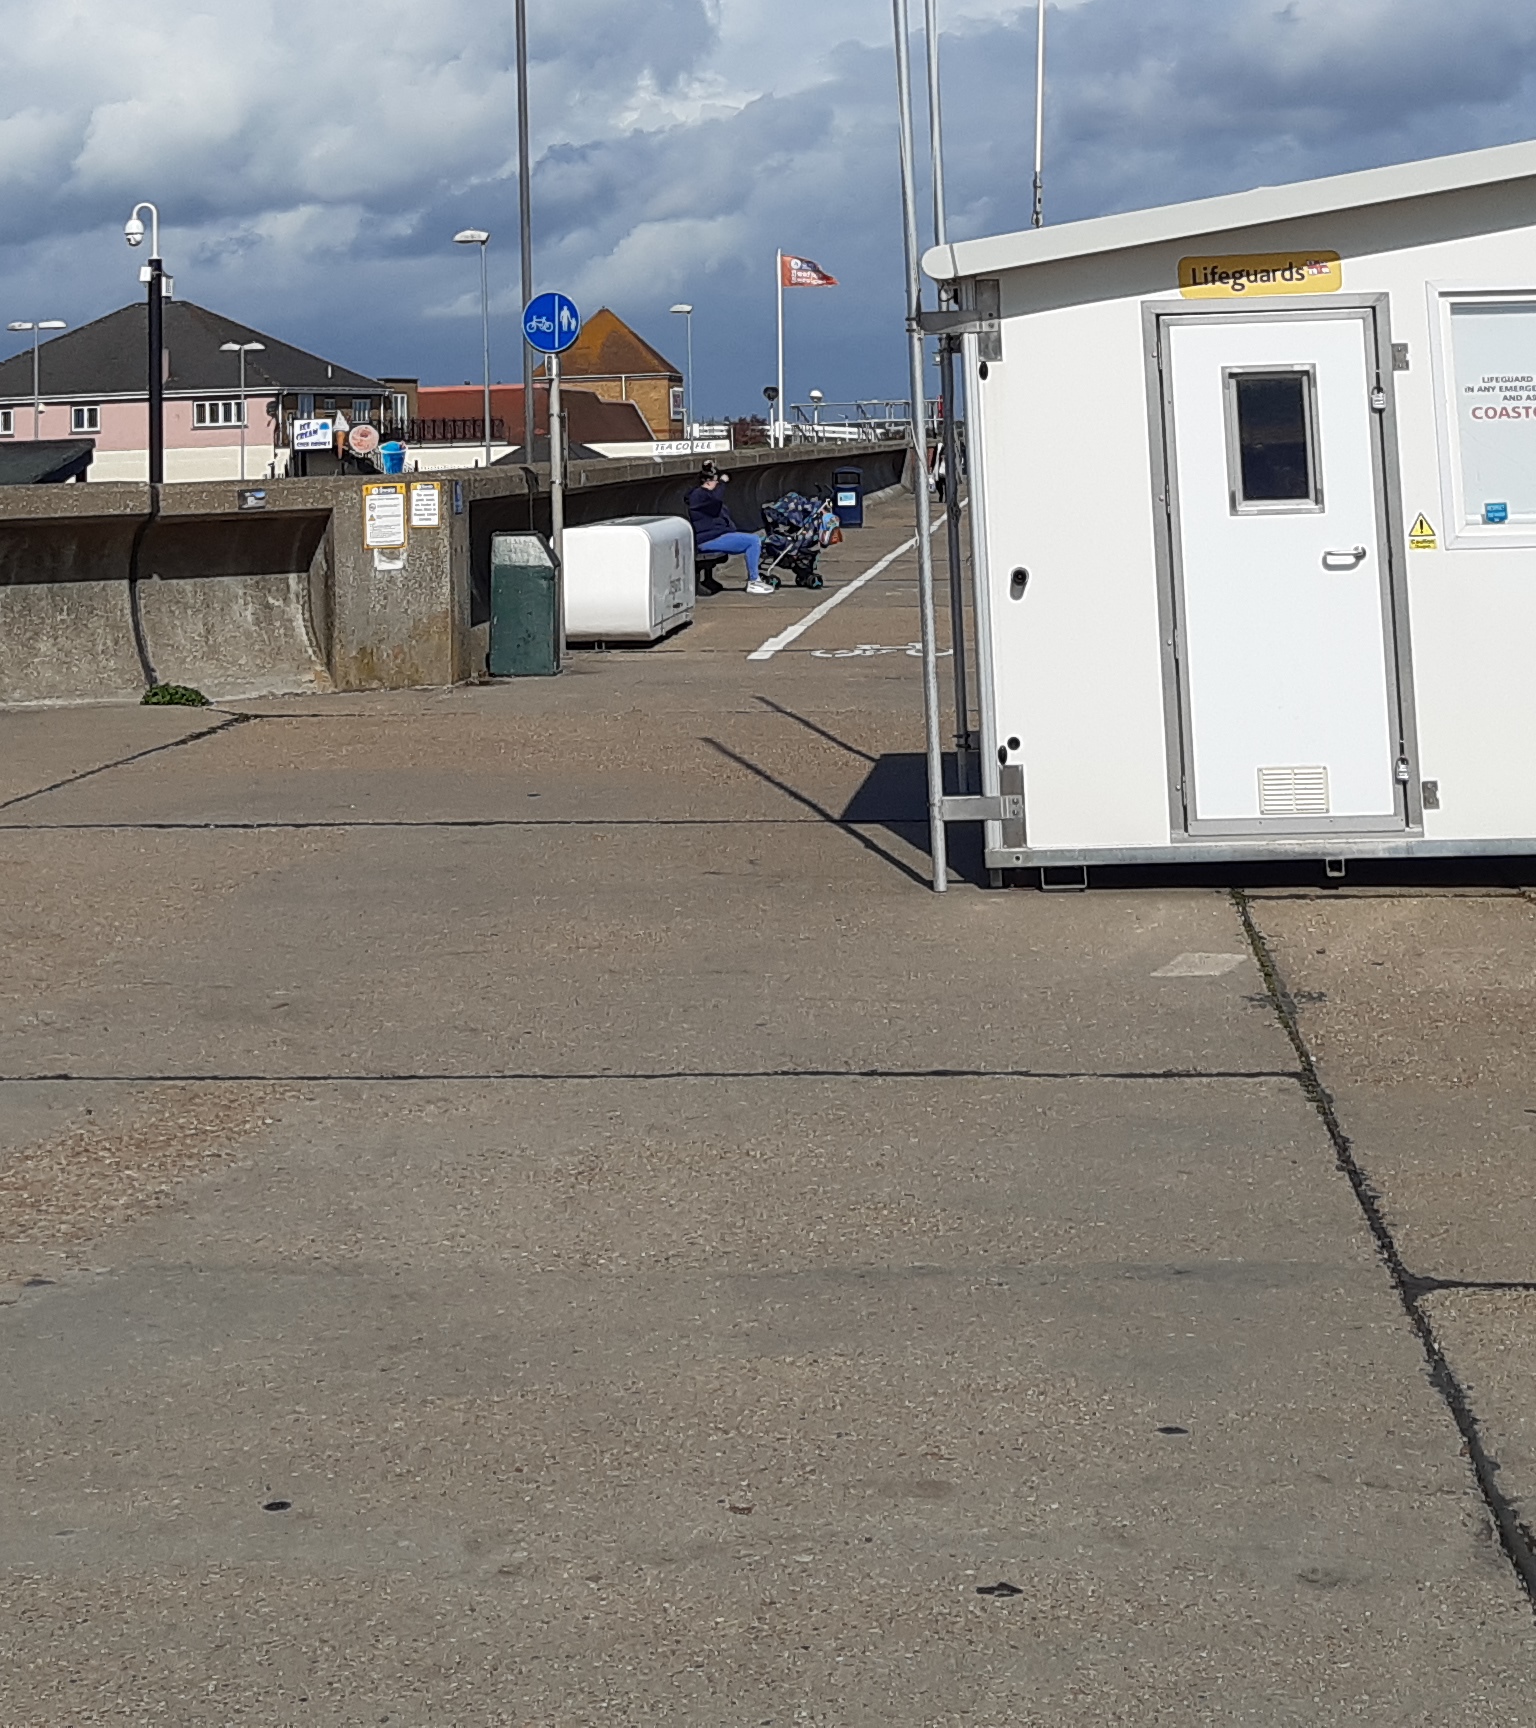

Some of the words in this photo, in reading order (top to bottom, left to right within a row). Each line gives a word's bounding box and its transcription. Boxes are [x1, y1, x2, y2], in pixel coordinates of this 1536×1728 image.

[1191, 262, 1305, 292] Lifeguards
[1482, 375, 1533, 384] LIFEGUARD
[1477, 385, 1496, 393] ANY
[1502, 394, 1523, 402] AND
[675, 441, 713, 452] COFEE
